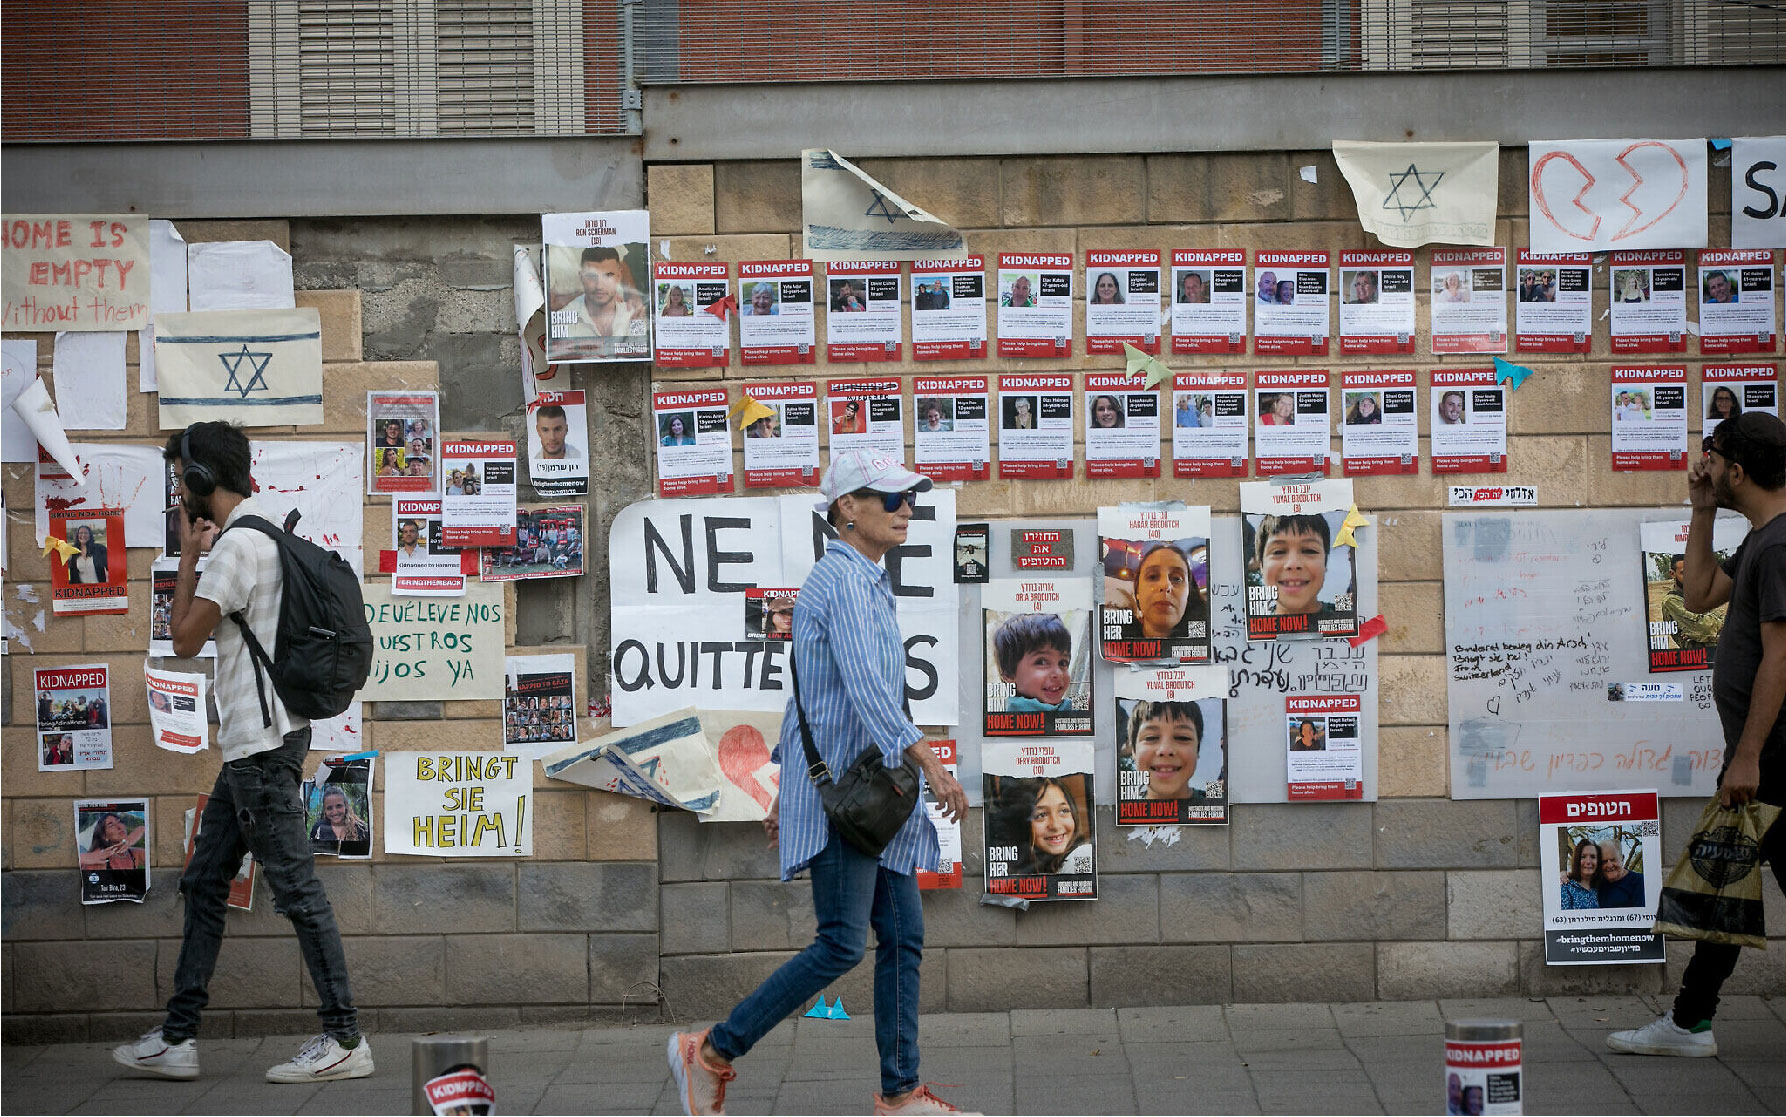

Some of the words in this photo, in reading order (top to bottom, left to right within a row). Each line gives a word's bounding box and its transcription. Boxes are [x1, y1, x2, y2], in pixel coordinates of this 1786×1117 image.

[88, 220, 128, 248] IS
[1002, 256, 1070, 266] KIDNAPPED
[1090, 254, 1158, 263] KIDNAPPED
[1175, 253, 1242, 262] KIDNAPPED
[1259, 254, 1326, 263] KIDNAPPED
[1343, 253, 1411, 263] KIDNAPPED
[1434, 252, 1501, 261] KIDNAPPED
[1520, 252, 1588, 261] KIDNAPPED
[1614, 252, 1682, 261] KIDNAPPED
[1702, 252, 1770, 263] KIDNAPPED
[742, 263, 810, 275] KIDNAPPED
[830, 262, 898, 270] KIDNAPPED
[913, 258, 983, 270] KIDNAPPED
[28, 259, 135, 290] EMPTY
[658, 265, 726, 276] KIDNAPPED
[88, 295, 148, 323] them
[551, 311, 578, 325] BRING
[552, 326, 568, 339] HIM
[1434, 373, 1497, 384] KIDNAPPE
[1616, 369, 1684, 378] KIDNAPPED
[1706, 367, 1774, 378] KIDNAPPED
[917, 380, 984, 390] KIDNAPPED
[1003, 378, 1070, 388] KIDNAPPED
[1089, 377, 1147, 387] KIDNAPPE
[1176, 376, 1244, 386] KIDNAPPED
[1259, 375, 1326, 386] KIDNAPPED
[1345, 374, 1412, 384] KIDNAPPED
[746, 385, 813, 396] KIDNAPPED
[657, 393, 725, 404] KIDNAPPED
[446, 445, 513, 453] KIDNAPPED
[401, 502, 441, 512] KIDNAP
[1023, 531, 1060, 542] החזירו
[1148, 530, 1161, 539] (40)
[1034, 544, 1050, 555] את
[644, 513, 757, 601] NE
[1021, 557, 1066, 568] החטופים
[55, 586, 125, 600] KIDNAPPED
[763, 590, 800, 598] KIDNAP
[1249, 585, 1277, 601] BRING
[1104, 610, 1132, 624] BRING
[1250, 618, 1277, 632] HOME
[1280, 615, 1308, 631] NOW!
[1649, 621, 1677, 637] BRING
[1104, 626, 1122, 640] HER
[372, 631, 472, 653] UESTROS
[1650, 636, 1669, 650] HIM
[1104, 643, 1131, 657] HOME
[1132, 640, 1161, 657] NOW!
[1213, 645, 1255, 665] גבא
[1651, 652, 1678, 667] HOME
[1680, 648, 1707, 665] NOW!
[367, 660, 427, 684] ijOS
[613, 638, 786, 698] QUITTE
[40, 674, 104, 687] KIDNAPPED
[147, 677, 195, 692] KIDNAPPED
[1694, 676, 1712, 684] LET
[987, 683, 1016, 698] BRING
[987, 698, 1007, 712] HIM
[1289, 699, 1357, 710] KIDNAPPED
[1699, 702, 1711, 710] GO
[987, 715, 1013, 730] HOME
[1016, 713, 1045, 729] NOW!
[417, 756, 518, 787] BRINGT
[1120, 771, 1149, 786] BRING
[1120, 785, 1139, 800] HIM
[442, 787, 484, 812] SIE
[1120, 803, 1147, 817] HOME
[1150, 801, 1178, 816] NOW!
[1567, 801, 1631, 817] חטופים
[413, 795, 526, 854] HEIM!
[990, 847, 1018, 862] BRING
[990, 863, 1009, 877] HER
[990, 880, 1017, 894] HOME
[1019, 876, 1047, 893] NOW!
[1555, 934, 1654, 945] #bringthemhomenow
[1446, 1049, 1520, 1062] KIDNAPPED
